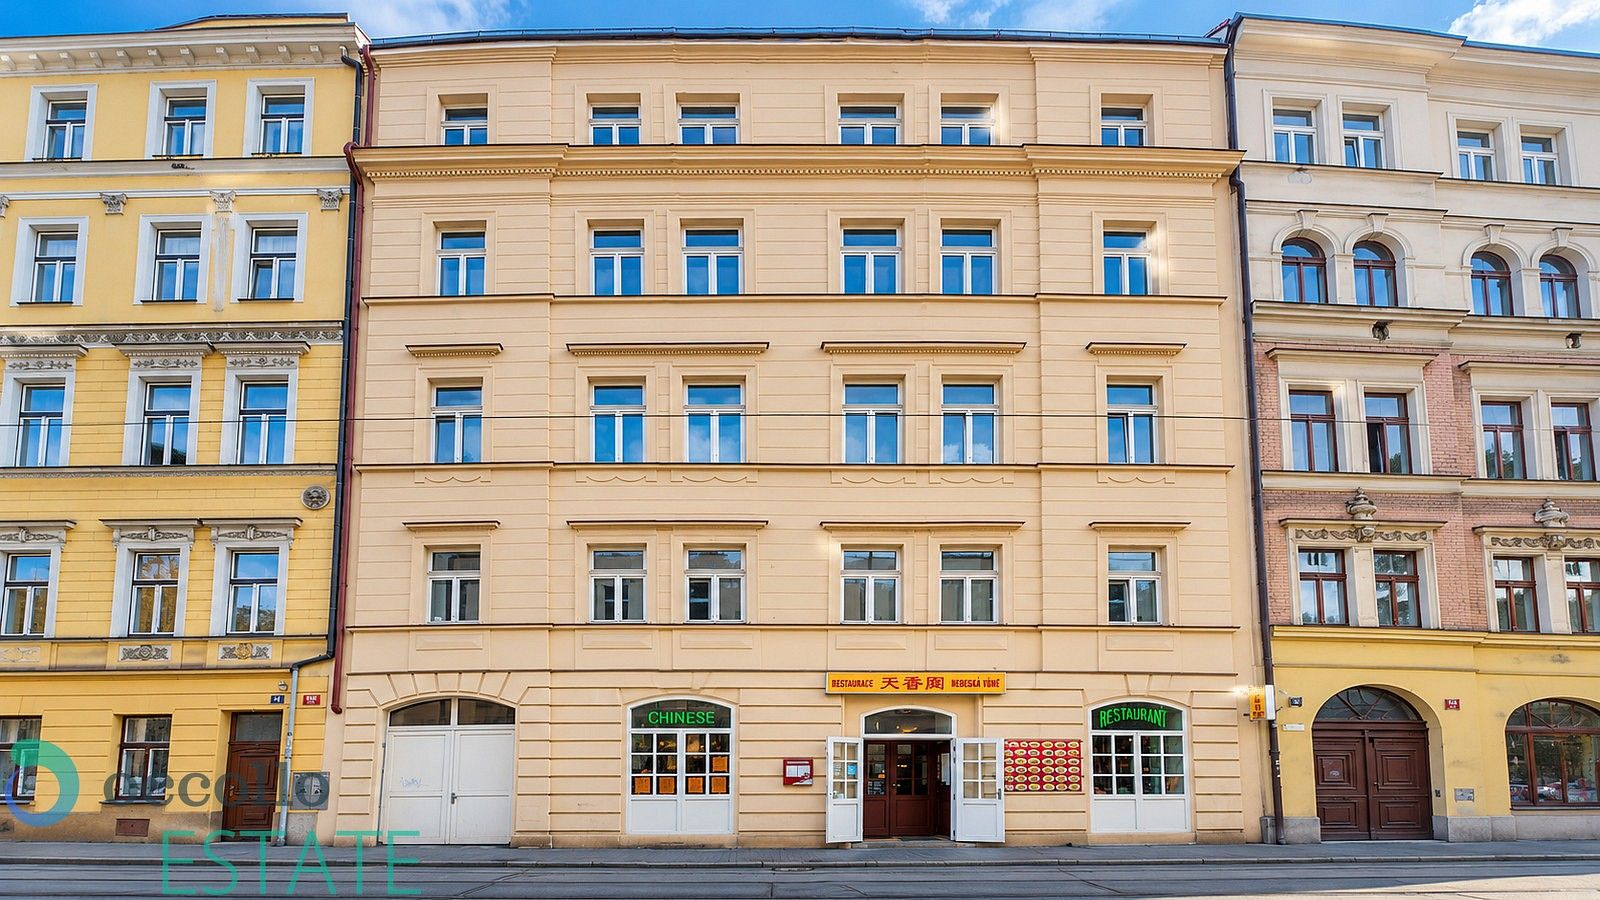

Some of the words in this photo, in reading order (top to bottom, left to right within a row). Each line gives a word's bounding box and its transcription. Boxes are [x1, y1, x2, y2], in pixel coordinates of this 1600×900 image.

[831, 679, 874, 688] RESTAURACE
[648, 711, 715, 724] CHINESE
[1100, 707, 1168, 728] RESTAURANT
